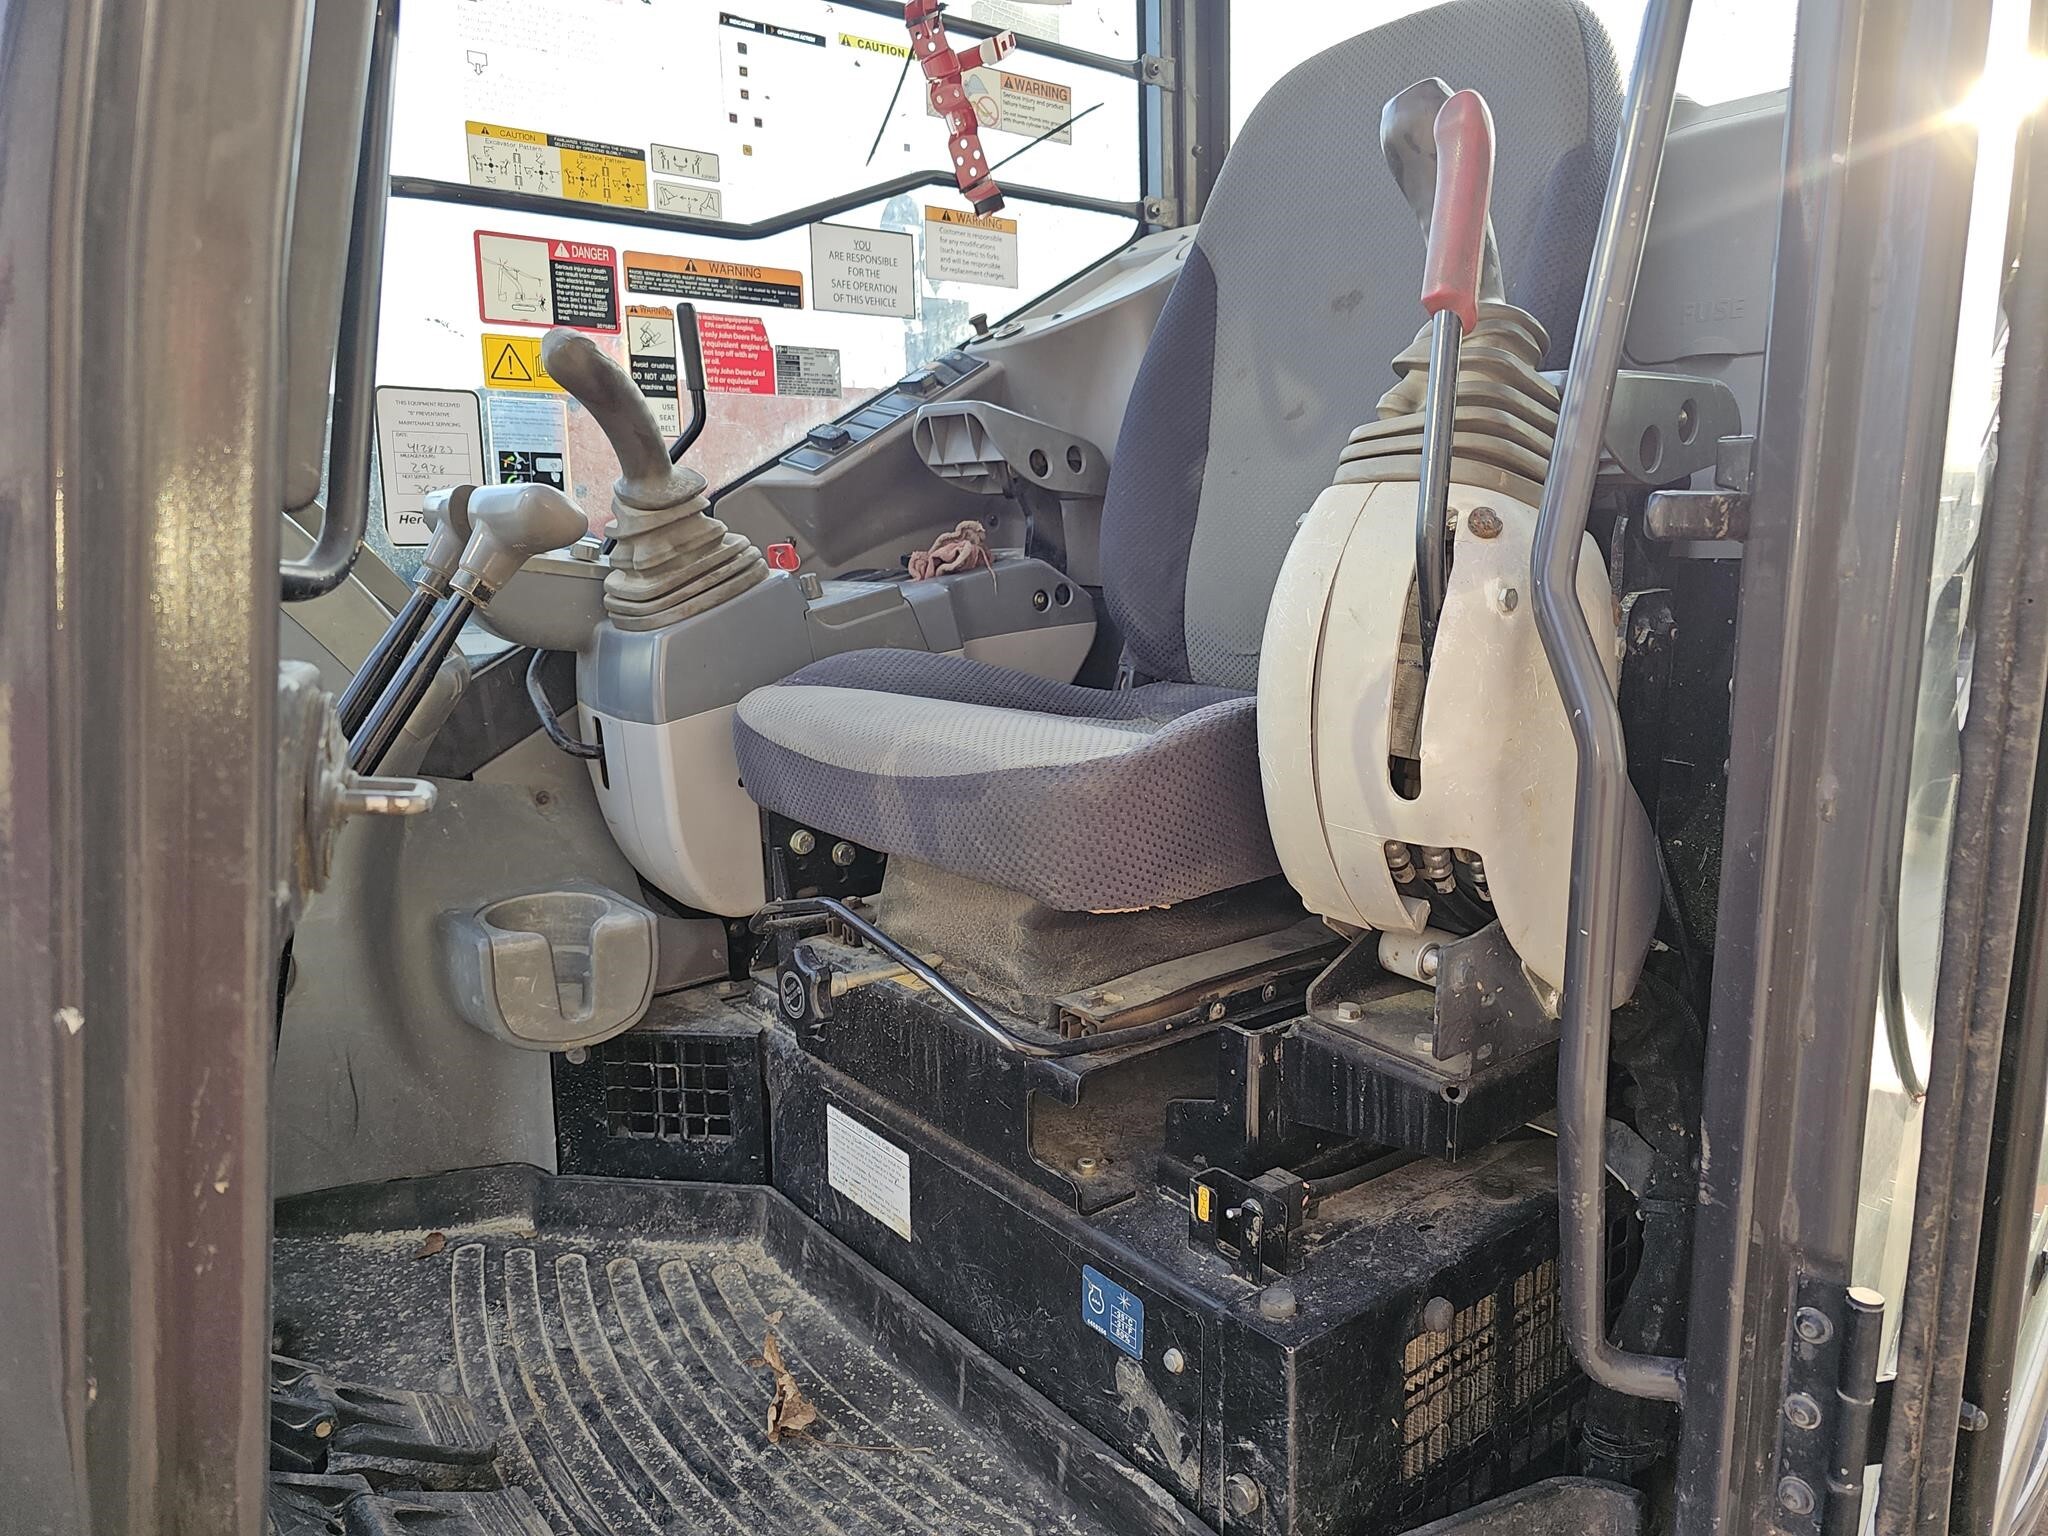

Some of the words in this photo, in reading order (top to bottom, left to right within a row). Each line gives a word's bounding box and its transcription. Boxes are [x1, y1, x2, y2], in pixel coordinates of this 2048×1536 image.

[857, 39, 905, 57] CAUTION
[1015, 78, 1068, 101] WARNING
[1003, 92, 1020, 100] Serious
[500, 129, 536, 142] CAUTION
[485, 138, 516, 148] Excavator
[518, 143, 542, 151] Pattern
[579, 153, 603, 161] Backhoe
[604, 156, 626, 164] Pattern
[956, 212, 1002, 230] WARNING
[939, 227, 966, 236] Customer
[972, 232, 1002, 242] responsible
[854, 240, 872, 252] YOU
[949, 238, 958, 246] any
[960, 240, 995, 250] modifications
[572, 246, 609, 261] DANGER
[829, 251, 844, 261] ARE
[847, 253, 898, 267] RESPONSIBLE
[986, 252, 1000, 261] forks
[555, 263, 573, 271] Serious
[708, 263, 761, 279] WARNING
[949, 267, 983, 276] replacement
[971, 261, 1000, 270] responsible
[848, 267, 864, 277] FOR
[865, 268, 880, 279] THE
[832, 279, 851, 289] SAFE
[853, 281, 898, 294] OPERATION
[833, 293, 845, 302] OF
[846, 295, 863, 305] THIS
[865, 296, 896, 308] VEHICLE
[1680, 296, 1745, 325] FUSE
[705, 331, 718, 339] only
[706, 340, 739, 349] equivalent
[715, 350, 724, 358] top
[651, 362, 674, 370] crushing
